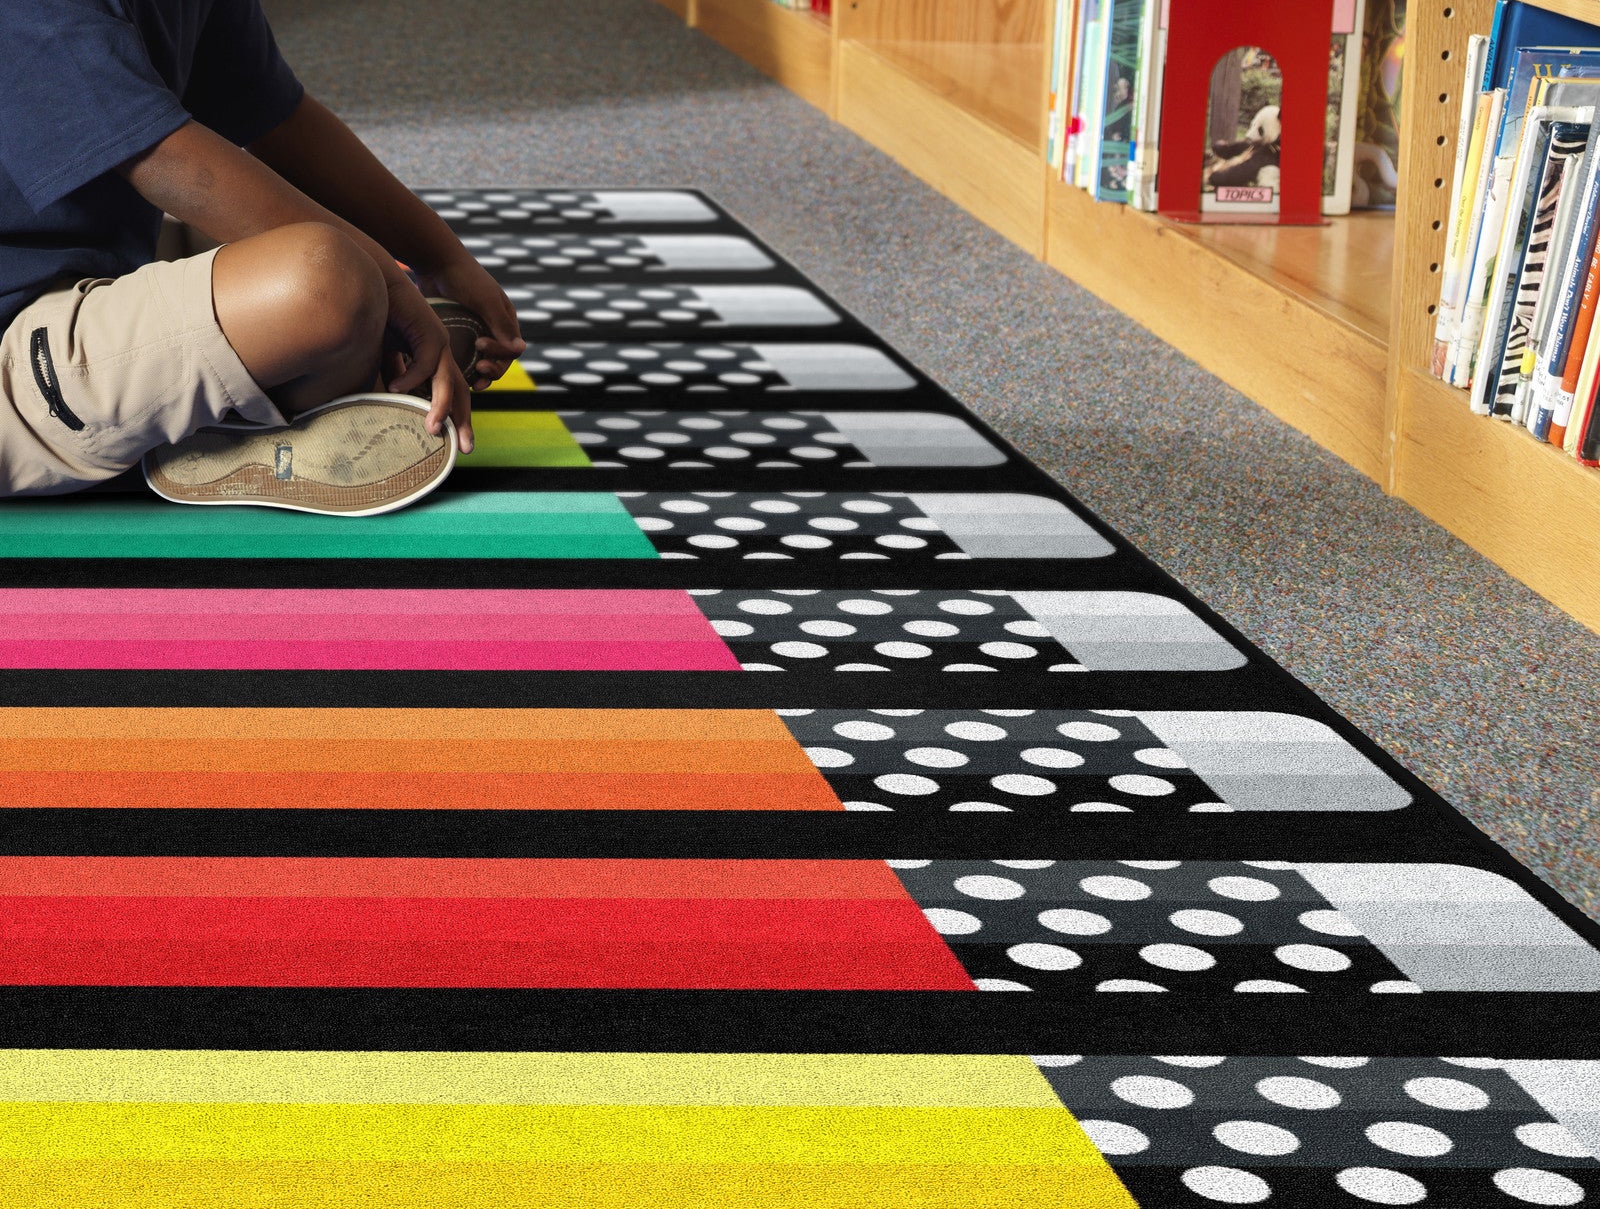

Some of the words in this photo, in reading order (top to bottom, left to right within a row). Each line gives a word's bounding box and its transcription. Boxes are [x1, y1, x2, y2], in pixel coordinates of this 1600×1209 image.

[1483, 38, 1495, 82] ANIMALS
[1225, 189, 1265, 200] TOPICS
[1568, 255, 1581, 289] Animals
[1590, 256, 1597, 271] BE
[1584, 272, 1594, 301] EARLY
[1563, 289, 1573, 311] Don't
[1559, 312, 1569, 332] Wear
[1551, 332, 1565, 364] Pajamas
